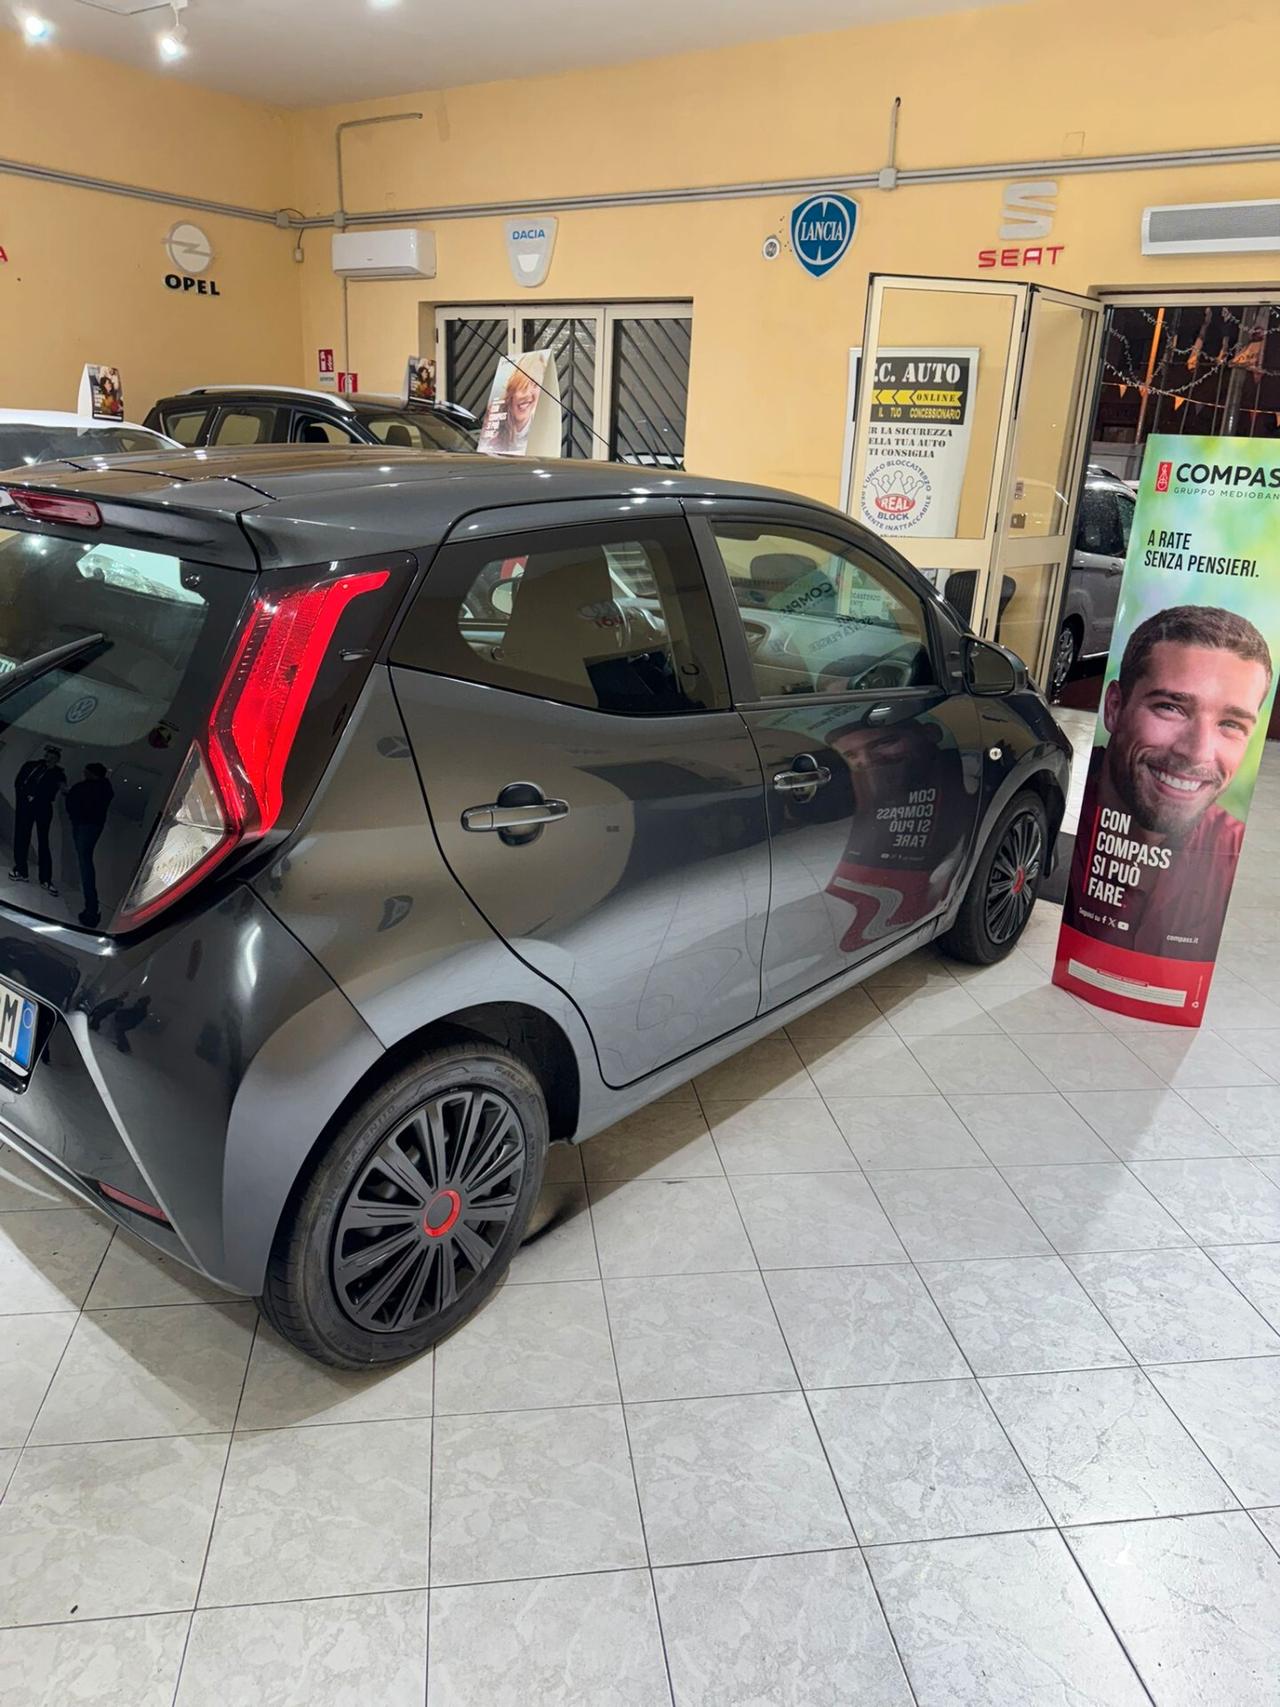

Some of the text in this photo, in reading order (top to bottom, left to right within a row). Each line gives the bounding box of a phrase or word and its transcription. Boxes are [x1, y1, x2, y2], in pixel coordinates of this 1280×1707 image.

[512, 229, 545, 240] DACIA
[800, 220, 844, 241] LANCIA
[978, 246, 1065, 268] SEAT
[164, 273, 220, 296] OPEL
[902, 362, 961, 384] AUTO
[915, 394, 956, 402] ONLINE
[909, 407, 961, 420] CONCESSIONARIO
[881, 427, 893, 435] LA
[895, 427, 953, 437] SICUREZZA
[895, 438, 915, 447] TUA
[918, 439, 946, 448] AUTO
[881, 449, 935, 459] CONSIGLIA
[1173, 486, 1215, 496] GRUPPO
[880, 496, 910, 510] REAL
[877, 511, 910, 521] BLOCK
[1147, 530, 1192, 551] A RATE
[1144, 550, 1260, 578] SENZA PENSIERI.
[1100, 808, 1131, 835] CON
[1096, 831, 1172, 870] COMPASS
[1092, 854, 1141, 887] SI PUÒ
[1166, 934, 1199, 944] compass.it
